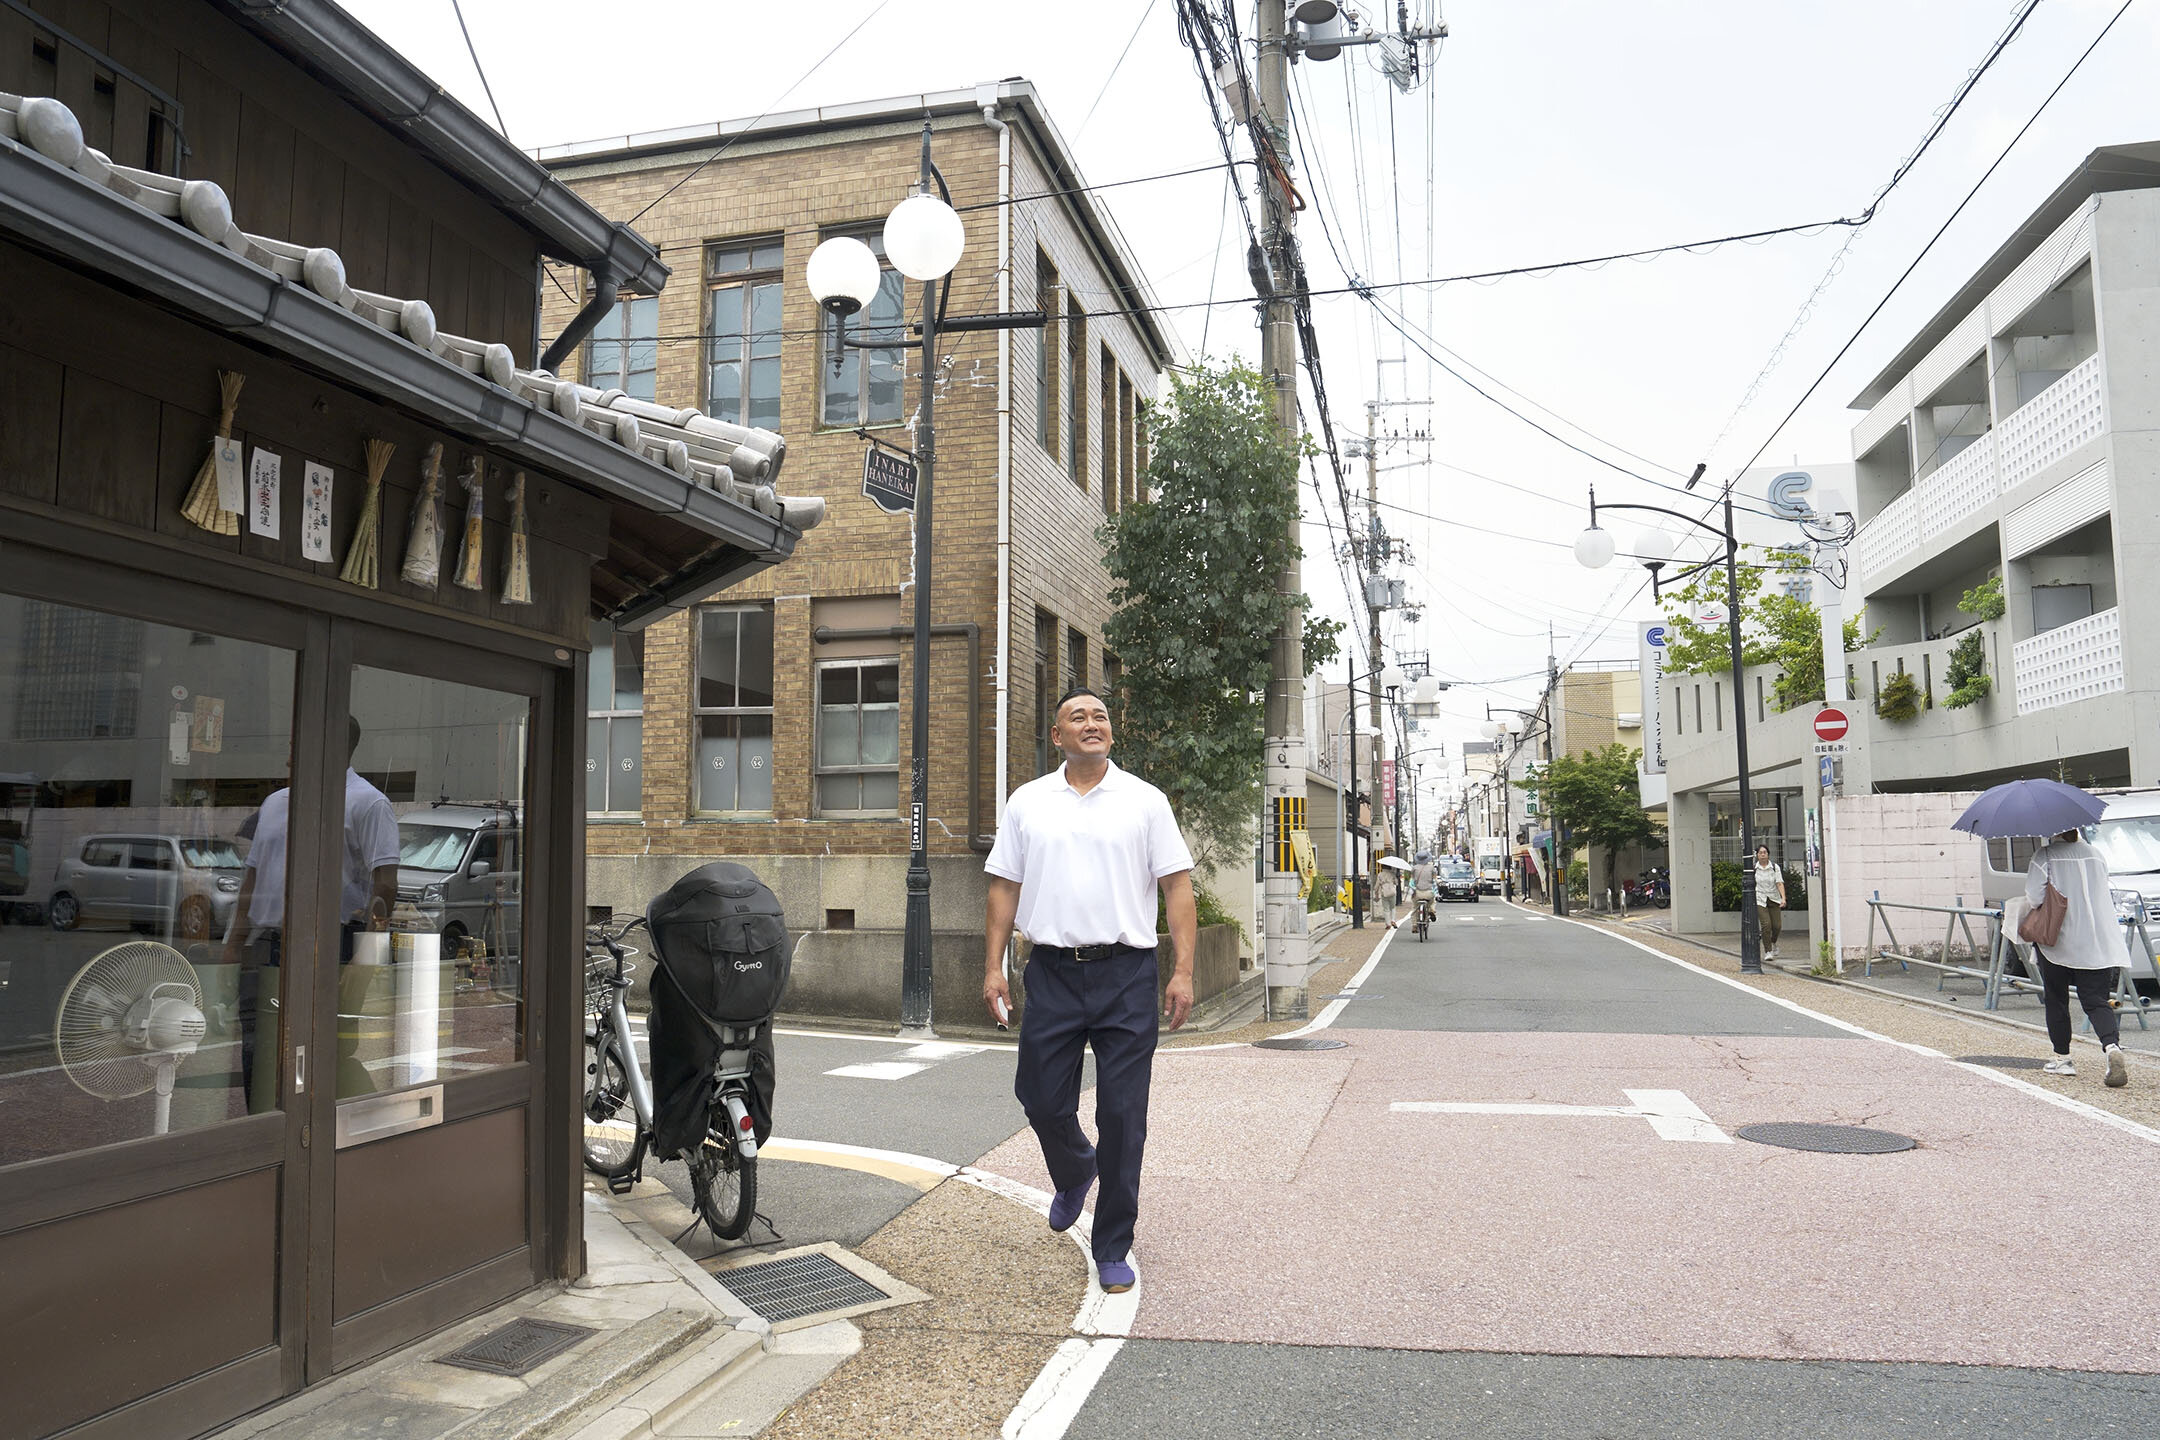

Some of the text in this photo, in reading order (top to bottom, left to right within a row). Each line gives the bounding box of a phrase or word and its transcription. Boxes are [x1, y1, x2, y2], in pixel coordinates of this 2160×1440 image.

[875, 455, 910, 479] INARI
[868, 467, 914, 495] HANEIKAI
[1814, 744, 1849, 753] 自転車を除く
